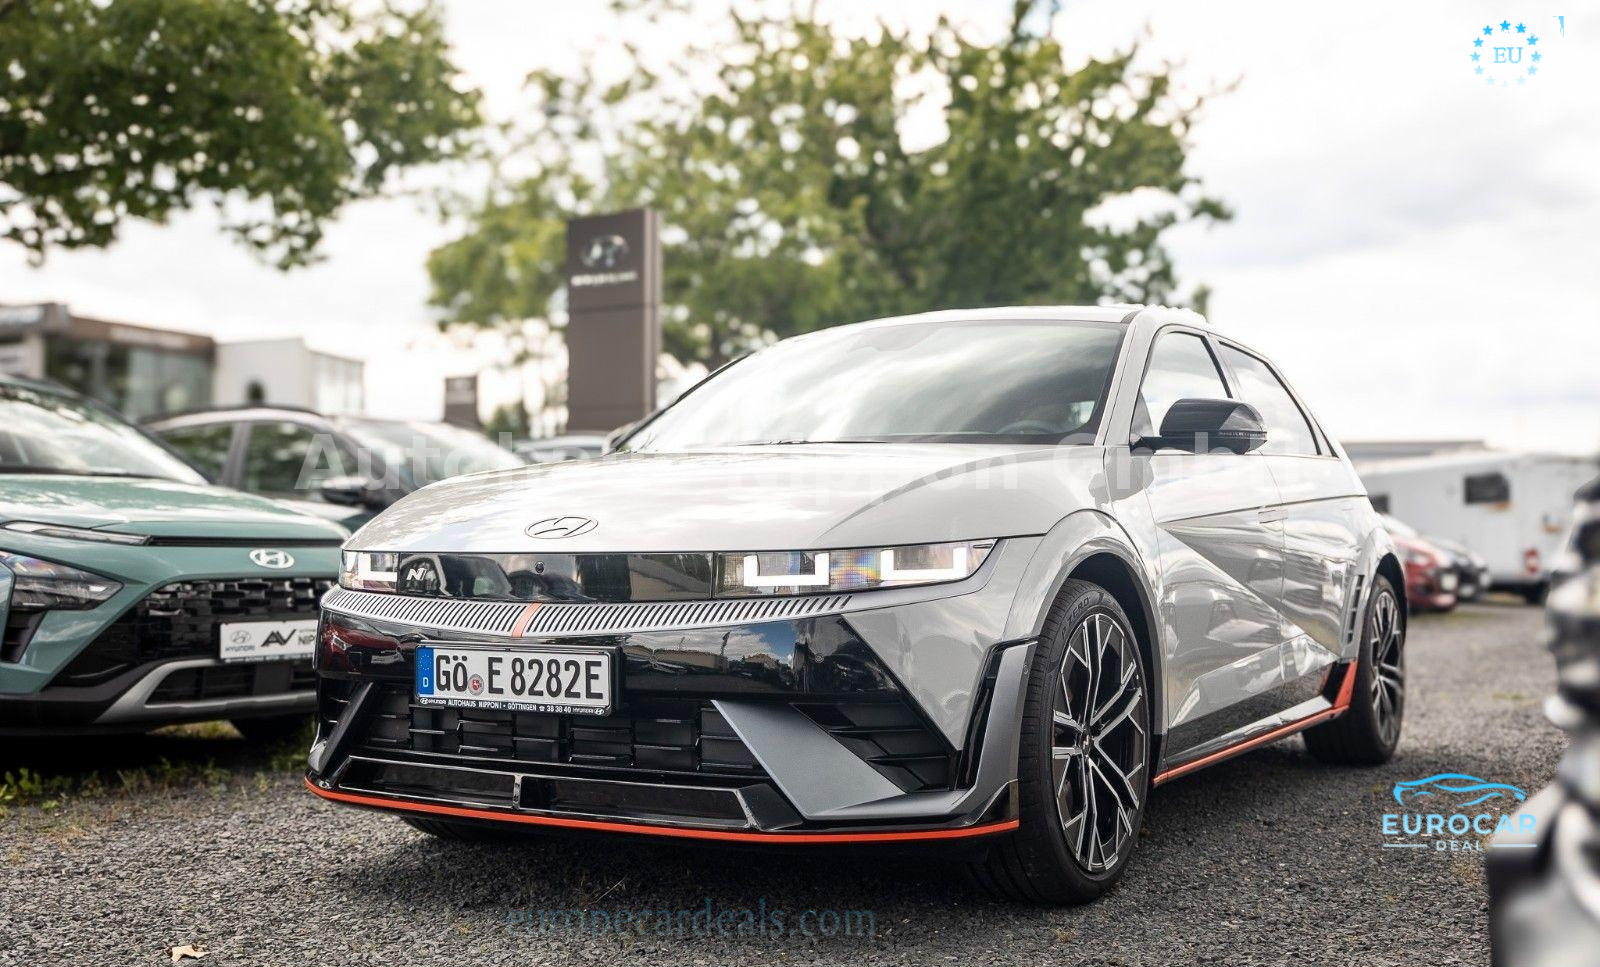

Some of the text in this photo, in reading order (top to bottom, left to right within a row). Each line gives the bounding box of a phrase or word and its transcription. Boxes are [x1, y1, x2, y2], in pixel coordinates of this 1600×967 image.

[435, 654, 604, 699] GÖ E 8282E
[422, 677, 429, 688] D
[447, 698, 476, 708] AUTOHAUS
